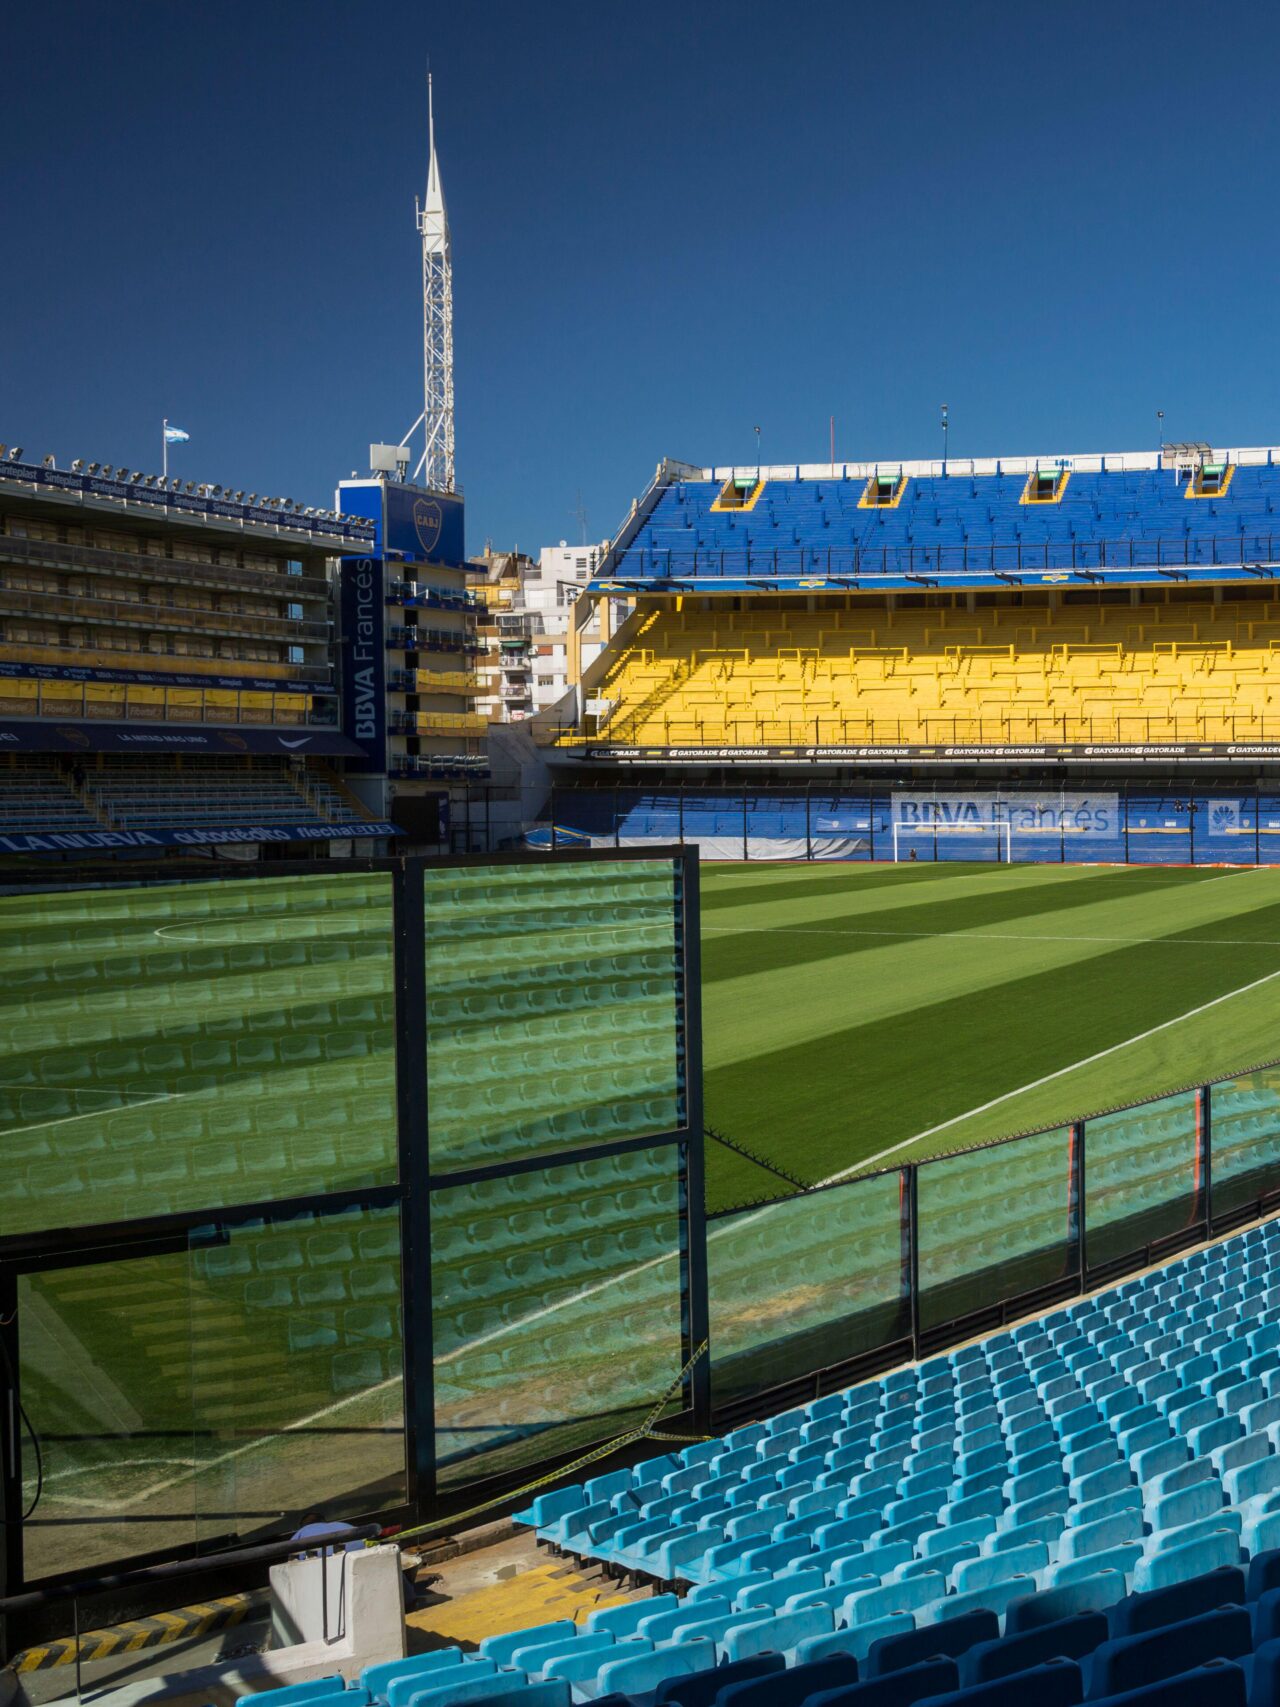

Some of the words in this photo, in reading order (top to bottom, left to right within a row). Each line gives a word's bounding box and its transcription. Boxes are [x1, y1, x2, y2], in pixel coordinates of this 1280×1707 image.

[44, 472, 83, 489] Sinteplast
[90, 480, 127, 496] Sinteplast
[134, 489, 167, 504] Sinteplast
[417, 516, 439, 529] CABJ
[351, 559, 375, 661] Francés
[355, 667, 376, 739] BBVA
[679, 749, 718, 757] GATORADE
[729, 749, 769, 757] GATORADE
[901, 801, 981, 830] BBVA
[991, 801, 1109, 831] Francés
[0, 835, 55, 852] LA
[50, 831, 164, 849] NUEVA
[173, 828, 291, 845] autocrédito
